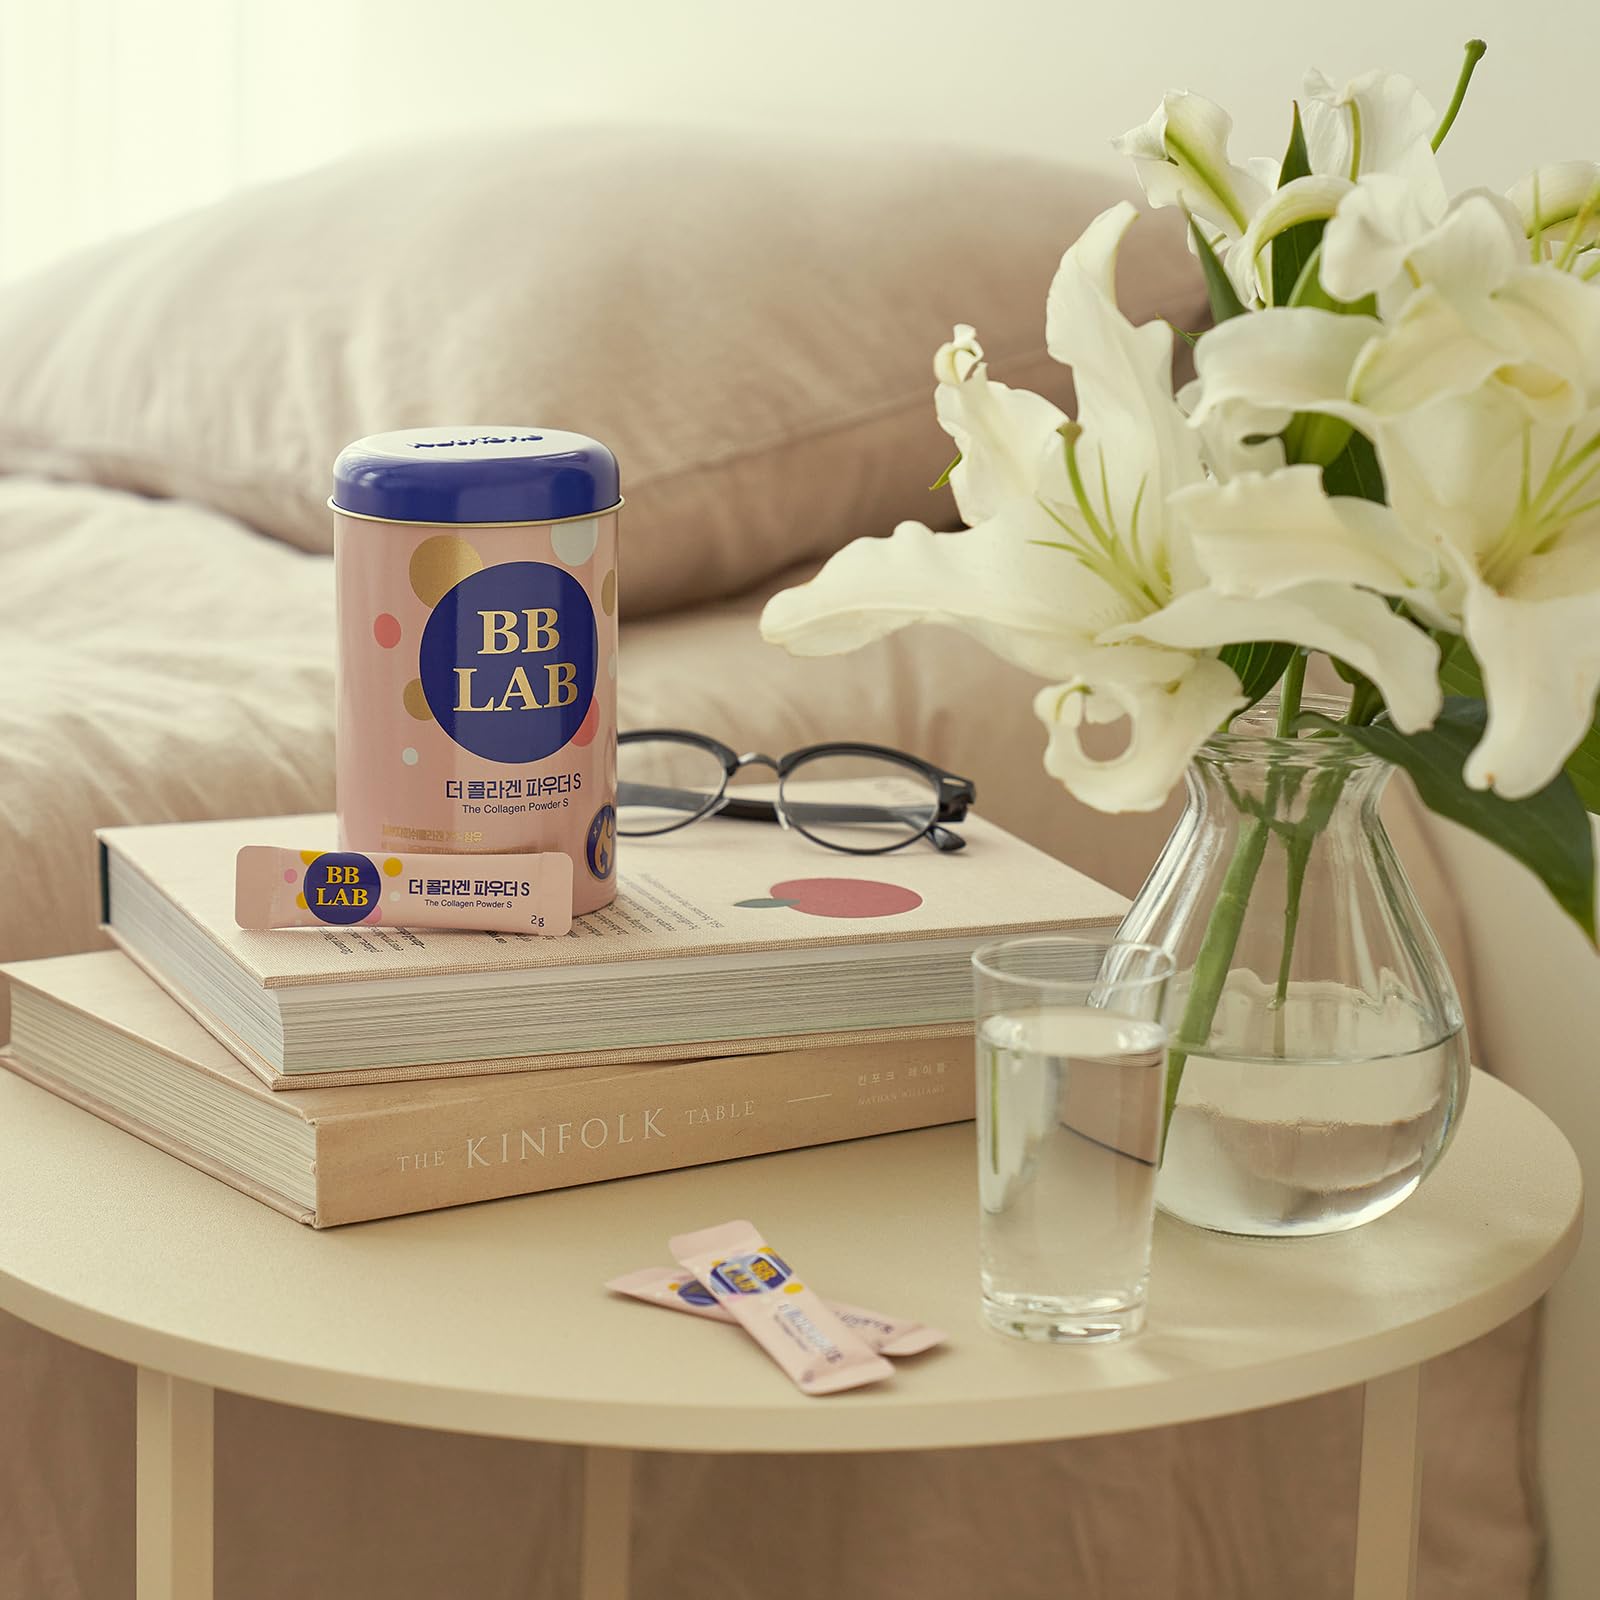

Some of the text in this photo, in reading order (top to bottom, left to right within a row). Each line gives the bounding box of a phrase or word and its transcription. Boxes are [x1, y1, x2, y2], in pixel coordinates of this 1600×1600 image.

[477, 607, 560, 655] BB
[452, 662, 578, 712] LAB
[446, 773, 581, 800] 더 콜라겐 파우더 S
[462, 799, 569, 815] The Collagen Powder S
[326, 866, 360, 884] BB
[316, 887, 369, 907] LAB
[409, 879, 530, 897] 더 콜라겐 파우더 S
[425, 900, 513, 910] The Collagen Powder S
[530, 915, 545, 928] 2g
[397, 1100, 755, 1172] THE KINFOLK TABLE
